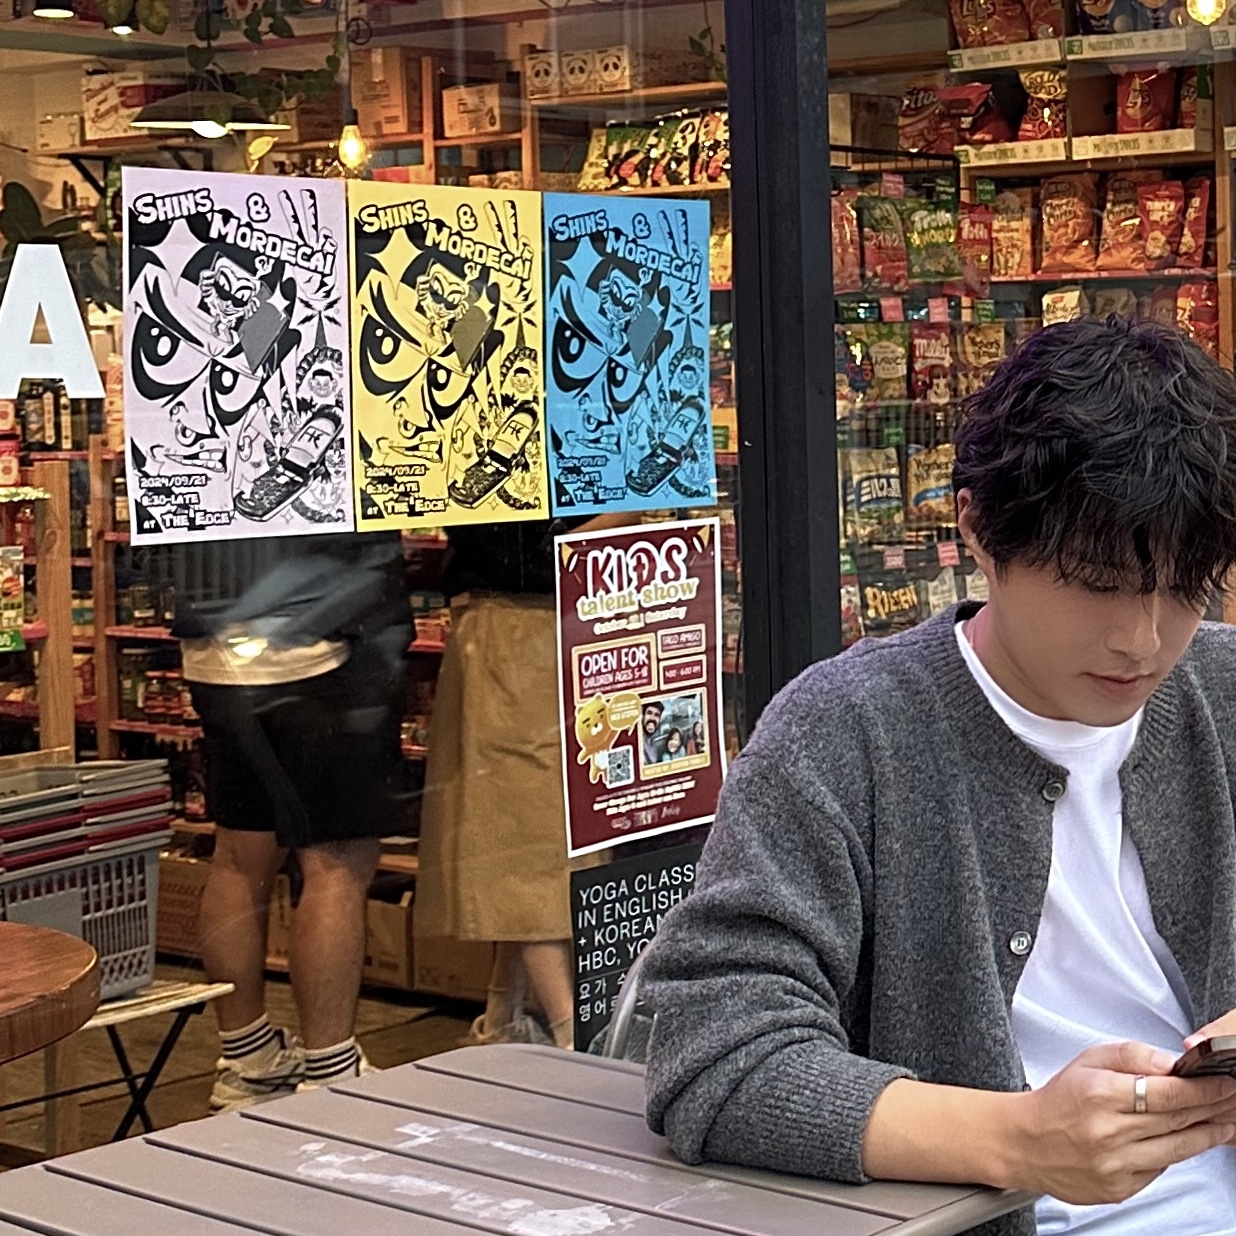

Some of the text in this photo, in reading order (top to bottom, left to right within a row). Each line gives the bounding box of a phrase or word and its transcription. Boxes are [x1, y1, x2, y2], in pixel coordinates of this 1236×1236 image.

[134, 188, 271, 225] SHINS &
[359, 199, 478, 234] SHINS &
[552, 209, 651, 242] SHINS &
[206, 211, 336, 276] MORDECAI
[422, 220, 532, 280] MORDECAI
[603, 231, 701, 283] MORDECAI
[0, 244, 104, 399] A
[139, 474, 208, 488] 2024/09/21
[364, 464, 427, 478] 2024/09/21
[162, 512, 190, 528] THE
[384, 500, 410, 515] THE
[587, 537, 688, 596] KIDS
[578, 578, 699, 620] talent show
[581, 645, 648, 676] OPEN FOR
[582, 672, 614, 688] CHILDREN
[614, 669, 633, 682] AGES
[578, 863, 695, 906] YOGA CLASS
[578, 888, 683, 929] IN ENGLISH
[578, 936, 587, 947] +
[578, 947, 621, 974] HBC,
[579, 976, 607, 1000] 요가
